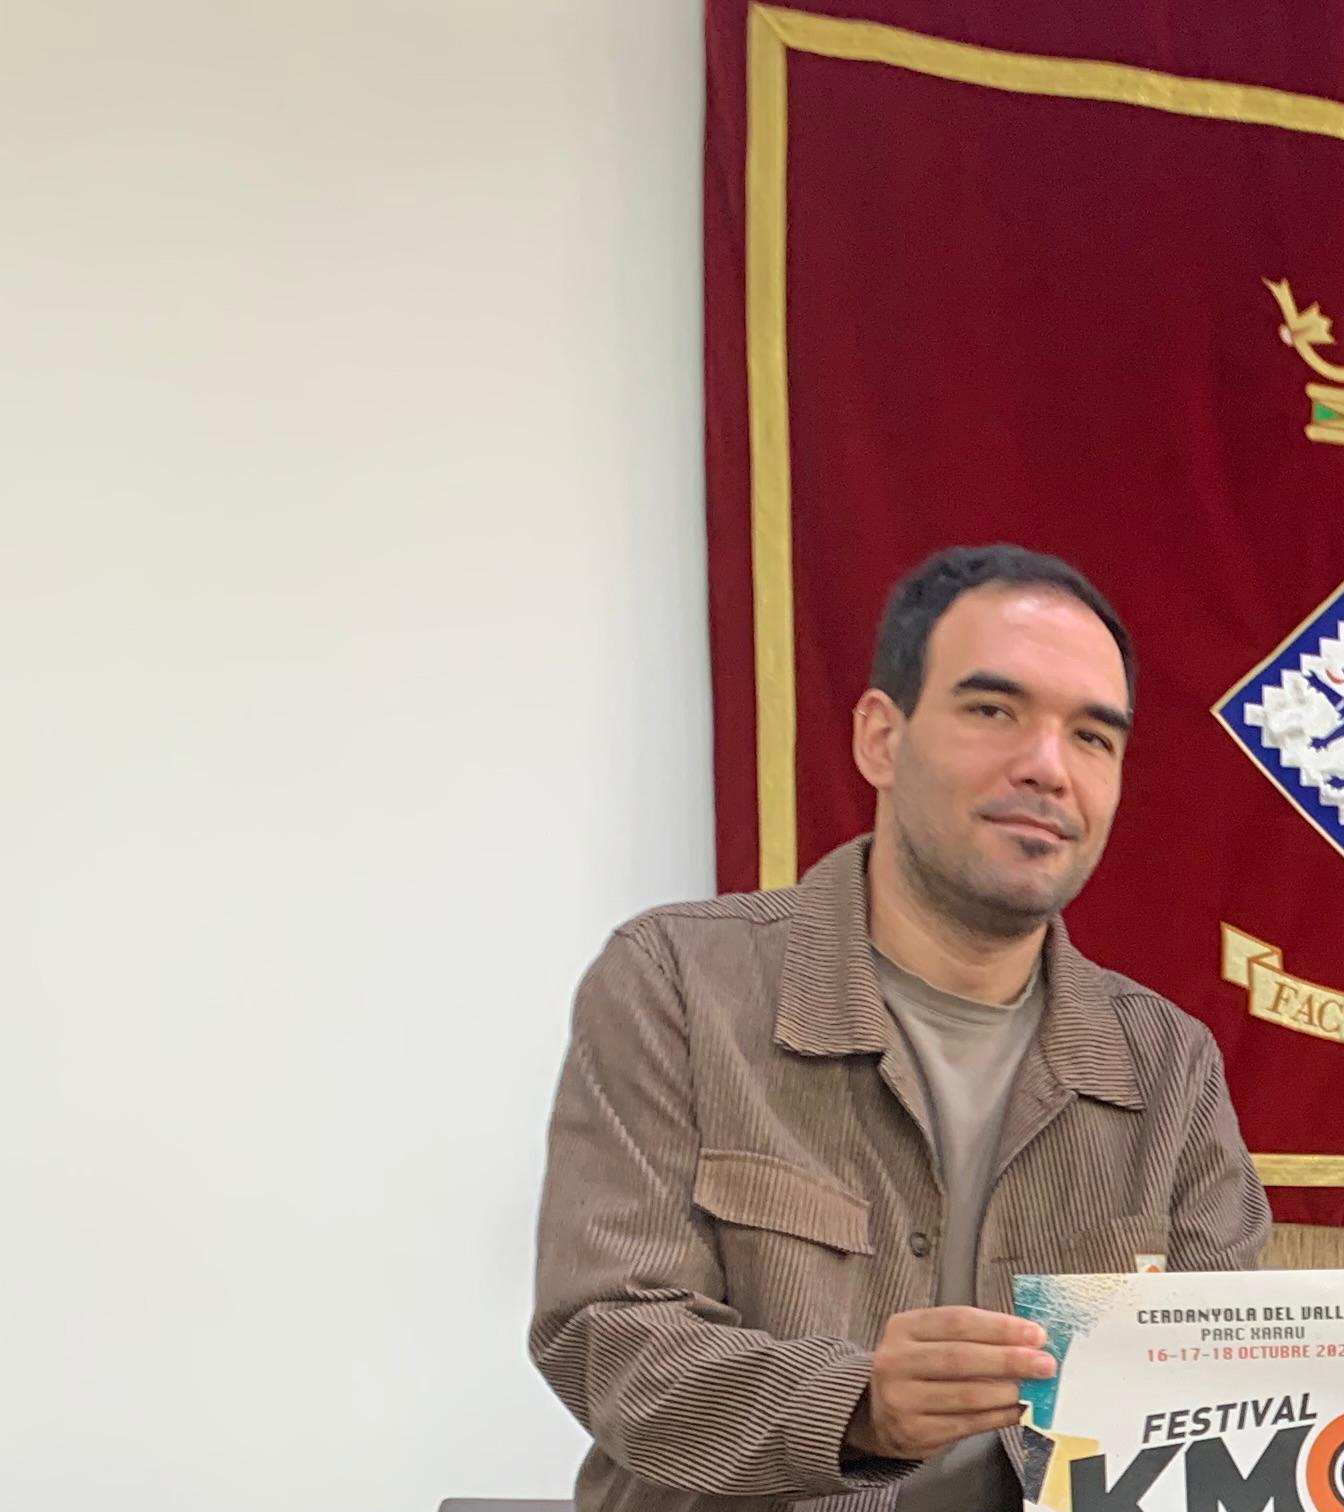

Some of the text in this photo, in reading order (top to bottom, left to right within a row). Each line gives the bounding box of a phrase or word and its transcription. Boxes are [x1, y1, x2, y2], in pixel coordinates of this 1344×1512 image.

[1137, 1307, 1256, 1324] CERDANYOLA
[1263, 1306, 1295, 1322] DEL
[1201, 1326, 1305, 1342] PARC XARAU
[1147, 1347, 1233, 1362] 16-17-18
[1238, 1345, 1310, 1359] OCTUBRE
[1142, 1392, 1318, 1444] FESTIVAL
